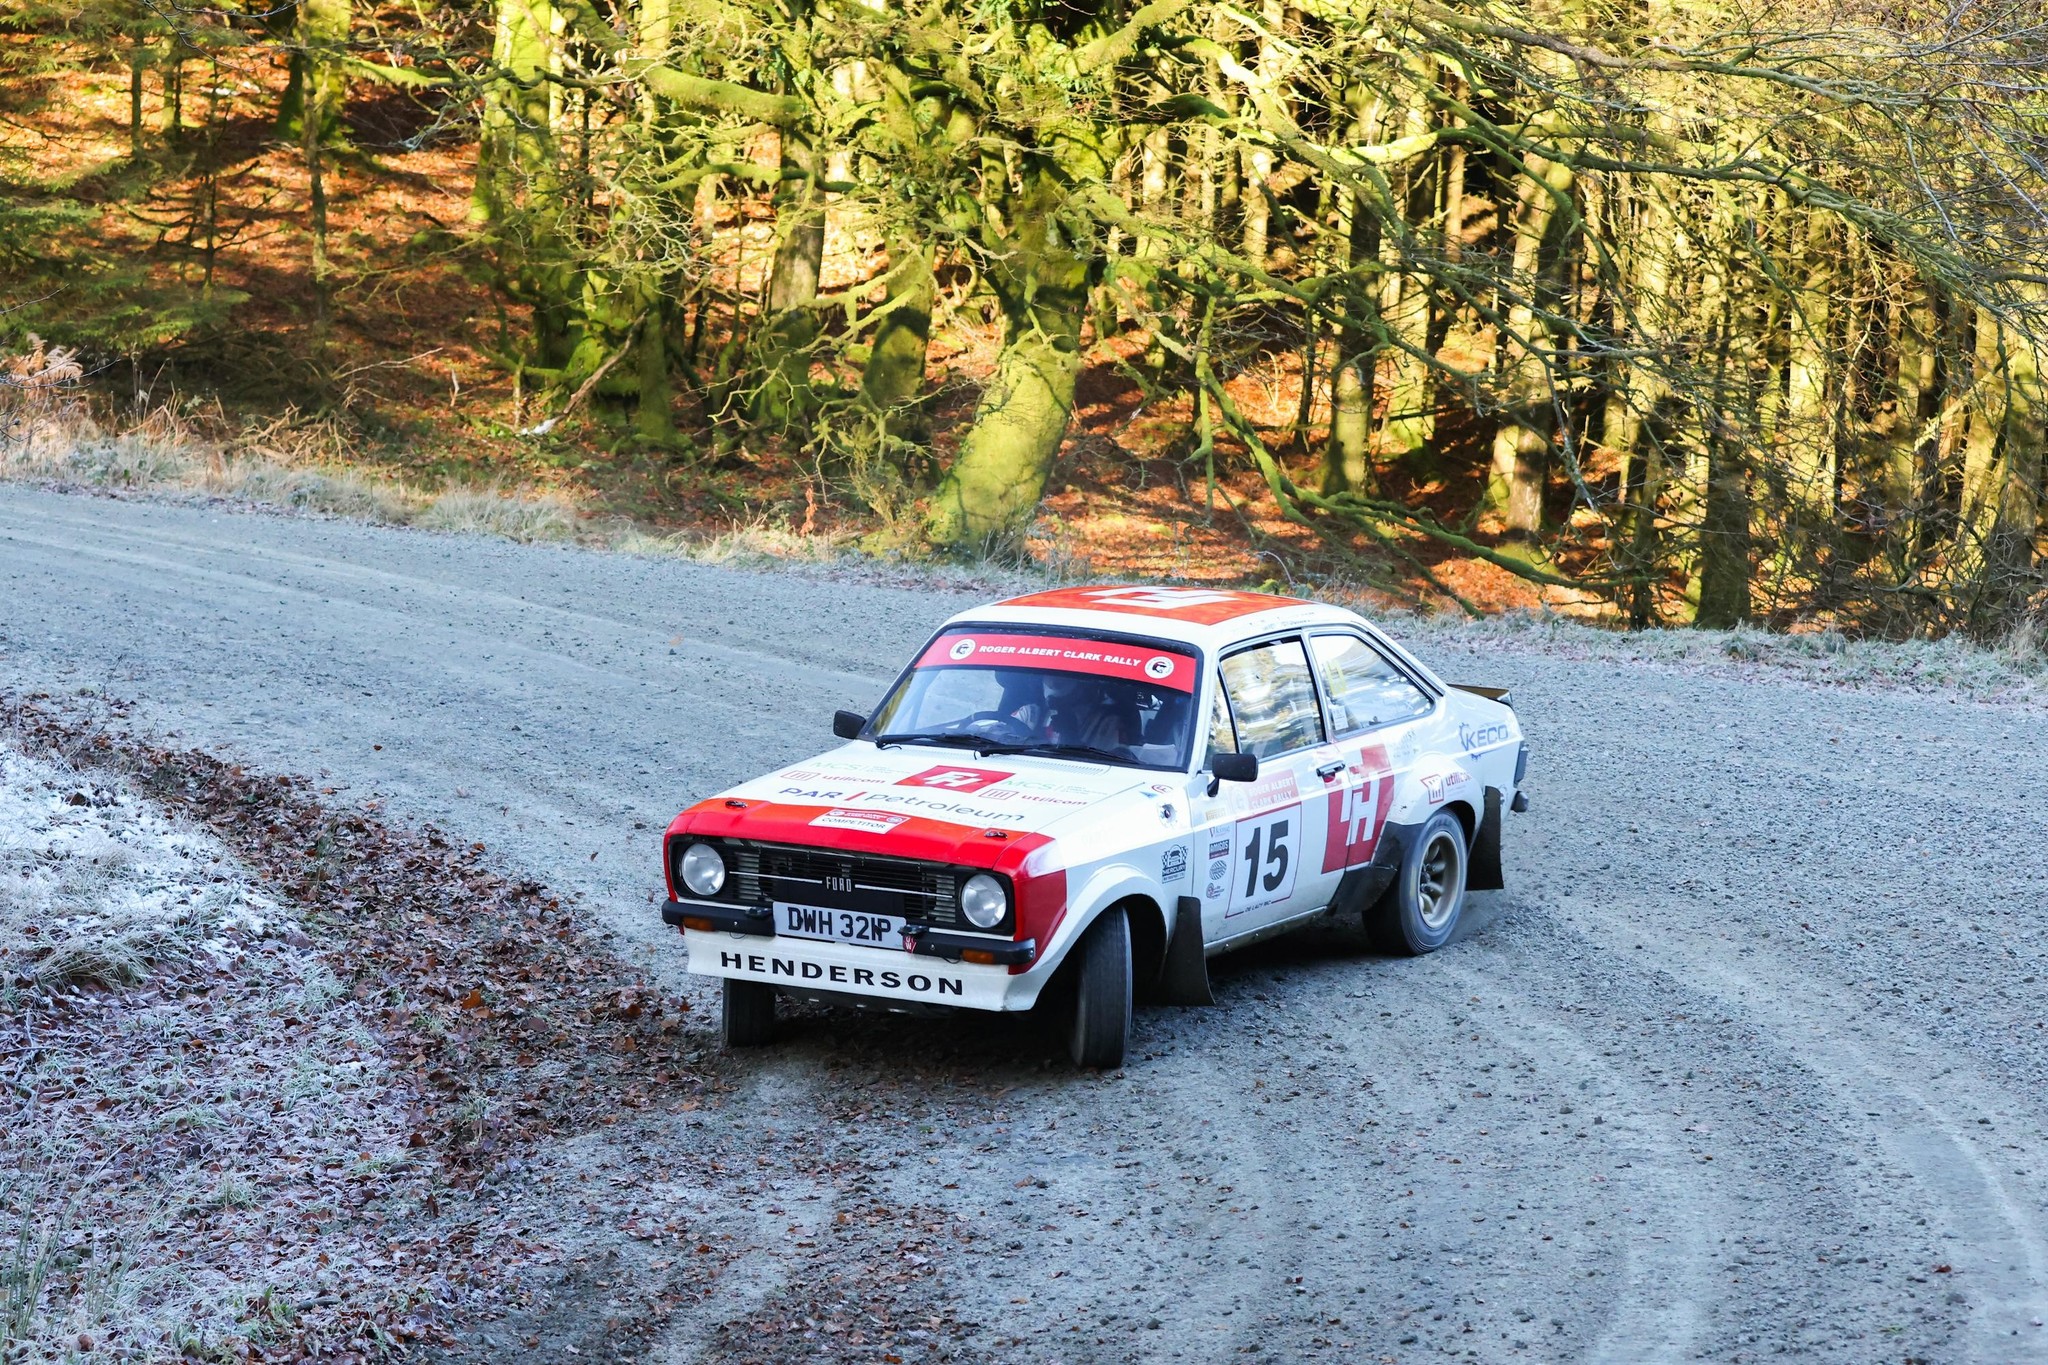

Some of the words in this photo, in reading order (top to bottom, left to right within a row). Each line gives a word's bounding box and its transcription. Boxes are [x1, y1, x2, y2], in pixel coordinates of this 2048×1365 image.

[979, 645, 1016, 654] ROGER
[1017, 647, 1062, 657] ALBERT
[1063, 650, 1102, 661] CLARK
[1103, 655, 1141, 667] RALLY
[1466, 724, 1509, 748] KECO
[822, 775, 886, 784] utilicom
[1271, 777, 1295, 791] ALBERT
[779, 788, 844, 799] PAR
[865, 794, 1025, 822] petroleum
[1021, 794, 1088, 806] utilicom
[1273, 791, 1292, 803] RALLY
[822, 817, 886, 829] COMPETITOR
[1245, 819, 1289, 898] 15
[826, 876, 852, 893] FORD
[788, 907, 832, 935] DWH
[840, 914, 891, 941] 321P
[720, 951, 964, 995] HENDERSON
